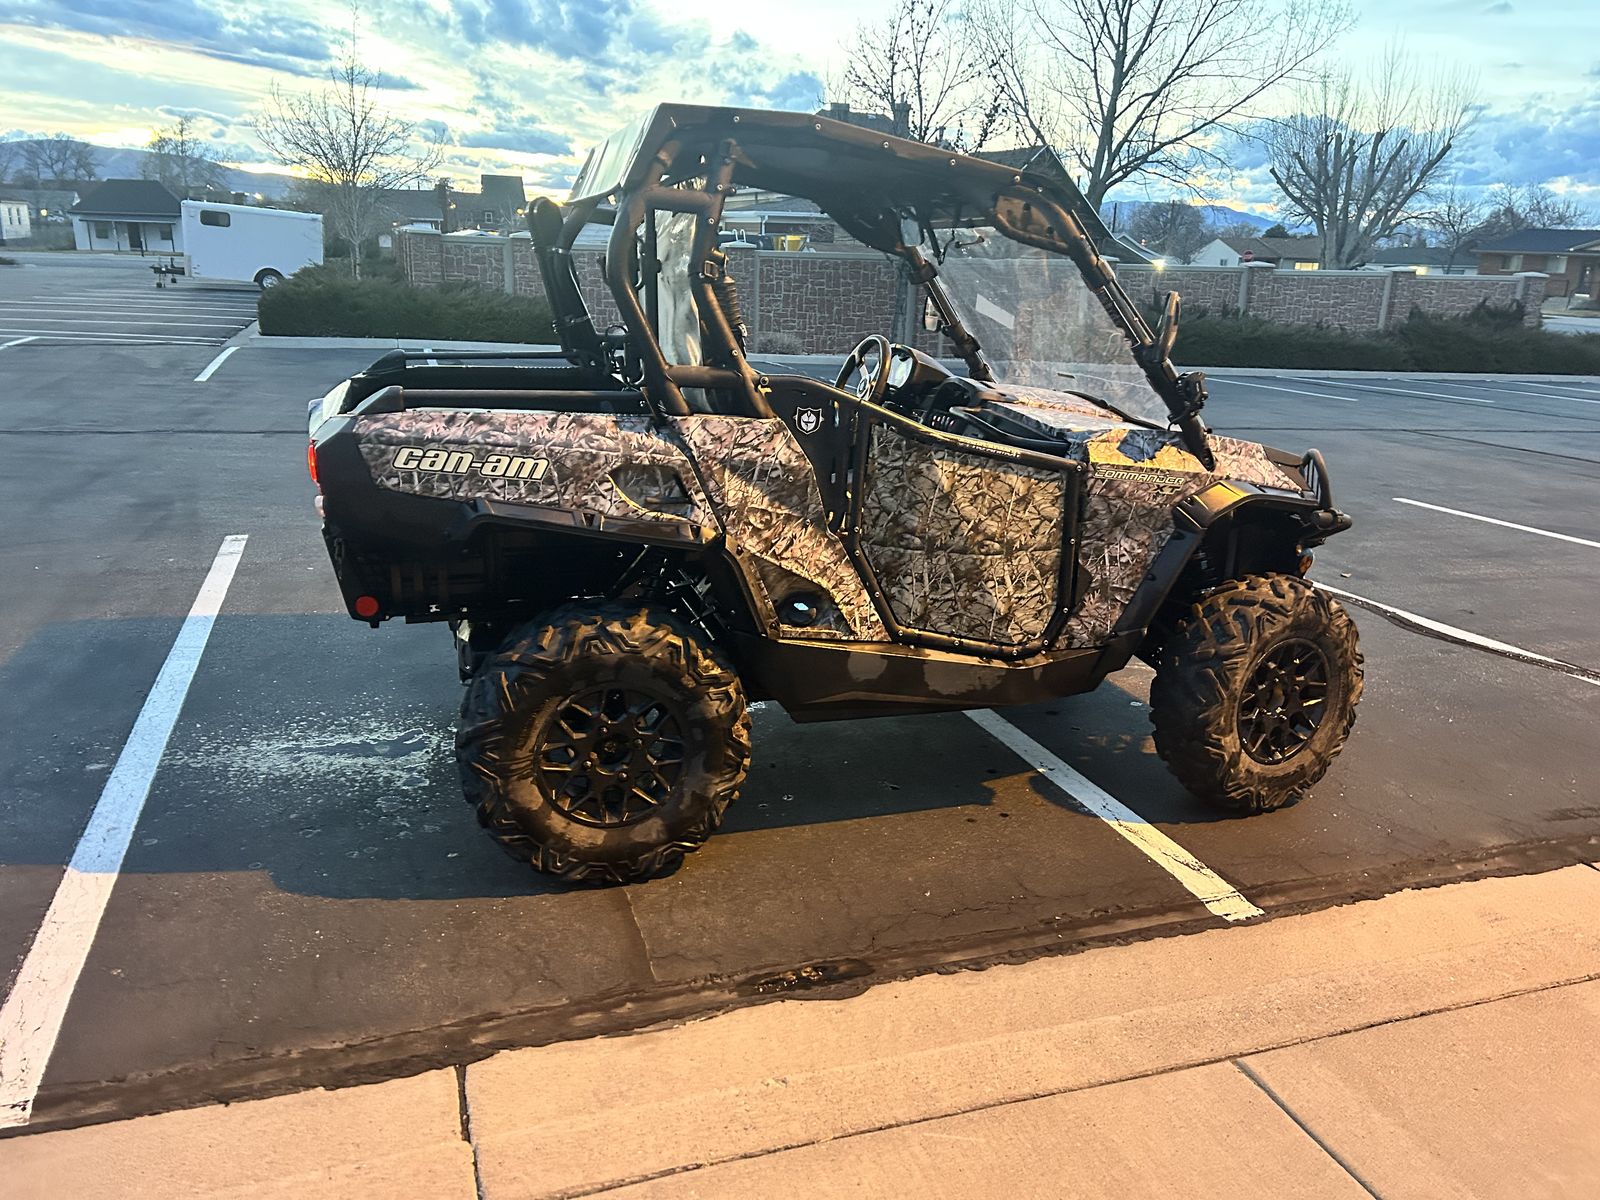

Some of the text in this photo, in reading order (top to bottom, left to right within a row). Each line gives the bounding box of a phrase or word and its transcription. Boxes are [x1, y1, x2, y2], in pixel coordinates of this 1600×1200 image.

[393, 447, 550, 480] can-am
[1094, 469, 1185, 486] COMMANDER
[1151, 484, 1182, 494] XT
